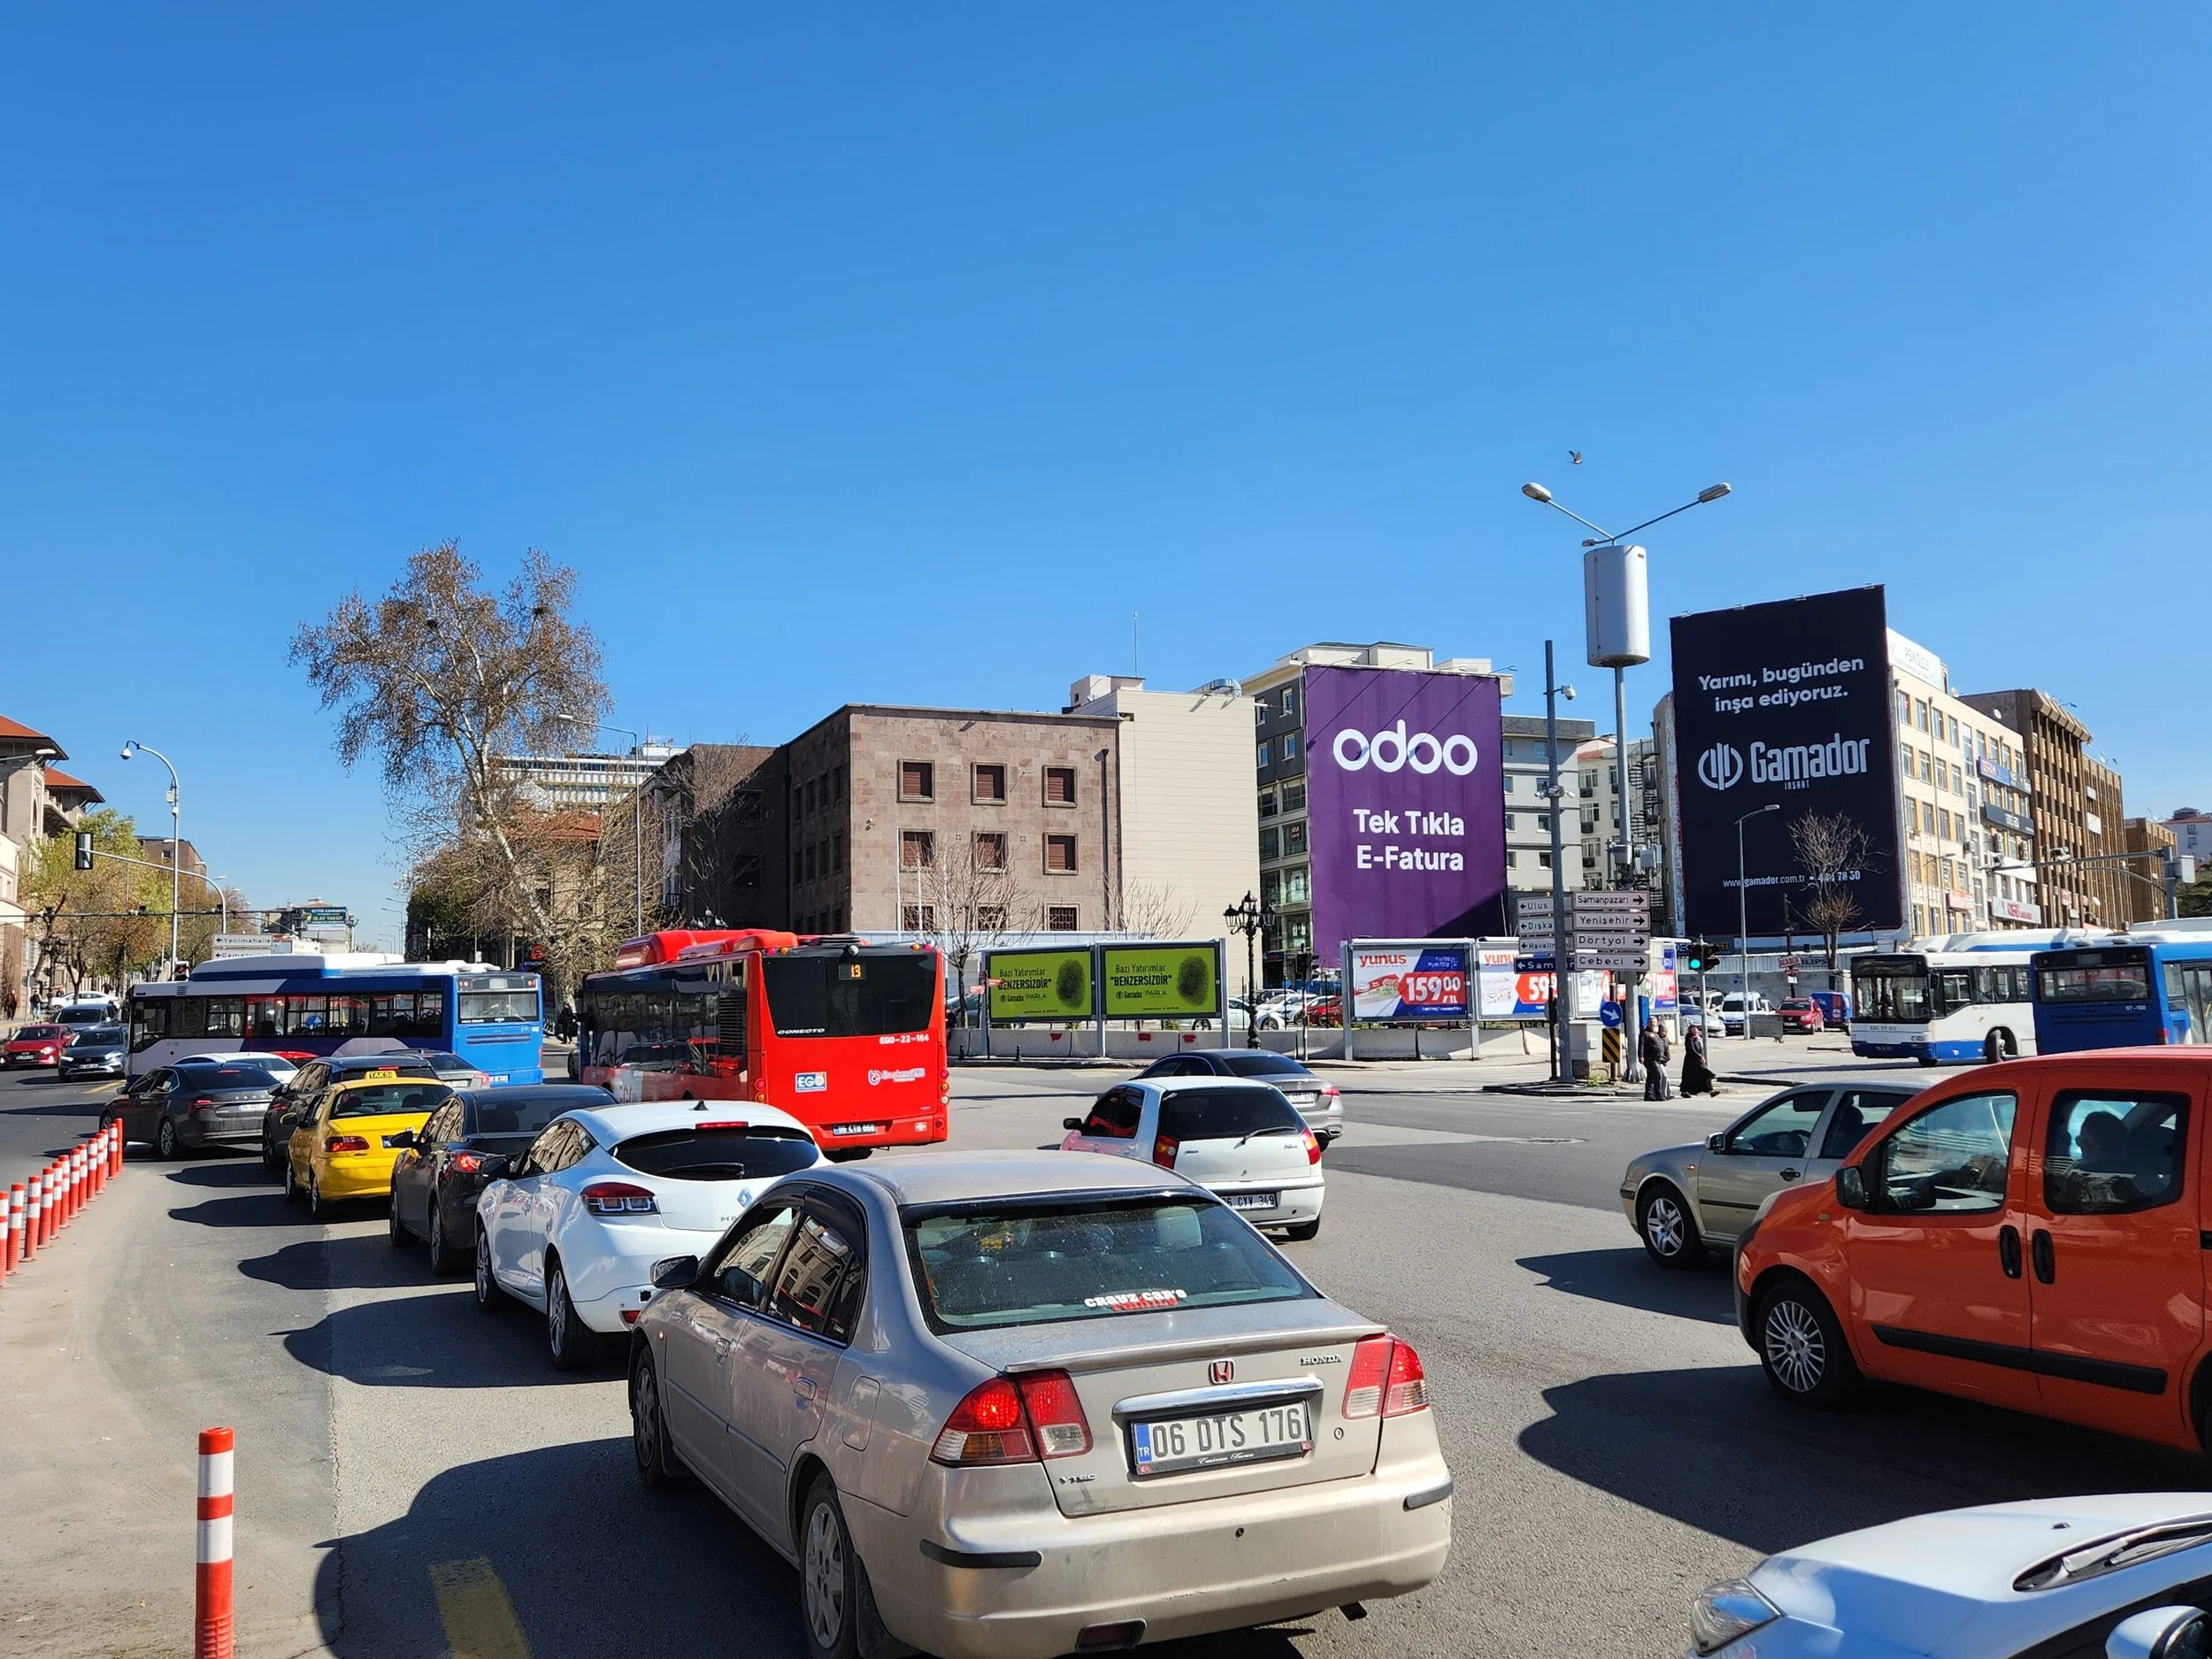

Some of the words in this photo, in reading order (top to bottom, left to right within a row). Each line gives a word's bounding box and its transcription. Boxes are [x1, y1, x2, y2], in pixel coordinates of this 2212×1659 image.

[1699, 672, 1757, 691] Yarını,
[1763, 657, 1864, 683] bugünden
[1715, 695, 1754, 714] inşa
[1758, 685, 1848, 707] ediyoruz.
[1333, 719, 1478, 776] odoo
[1750, 733, 1870, 783] Gamador
[1353, 809, 1400, 834] Tek
[1405, 810, 1464, 836] Tıkla
[1356, 845, 1464, 872] E-Fatura
[1578, 895, 1630, 905] Samanpazarı
[1579, 916, 1630, 925] Yenişehir
[1578, 936, 1626, 947] Dörtyol
[1359, 955, 1407, 968] yunus
[1579, 956, 1624, 965] Cebeci
[851, 964, 861, 978] 13
[999, 968, 1013, 978] Bazı
[1014, 967, 1046, 977] Yatırımlar
[1115, 964, 1130, 973] Bazı
[1132, 963, 1166, 973] Yatırımlar
[879, 1033, 929, 1045] EGO-22-164
[1300, 1355, 1343, 1366] HONDA
[1152, 1423, 1185, 1458] 06
[1258, 1408, 1302, 1443] 176
[1138, 1447, 1150, 1457] TR
